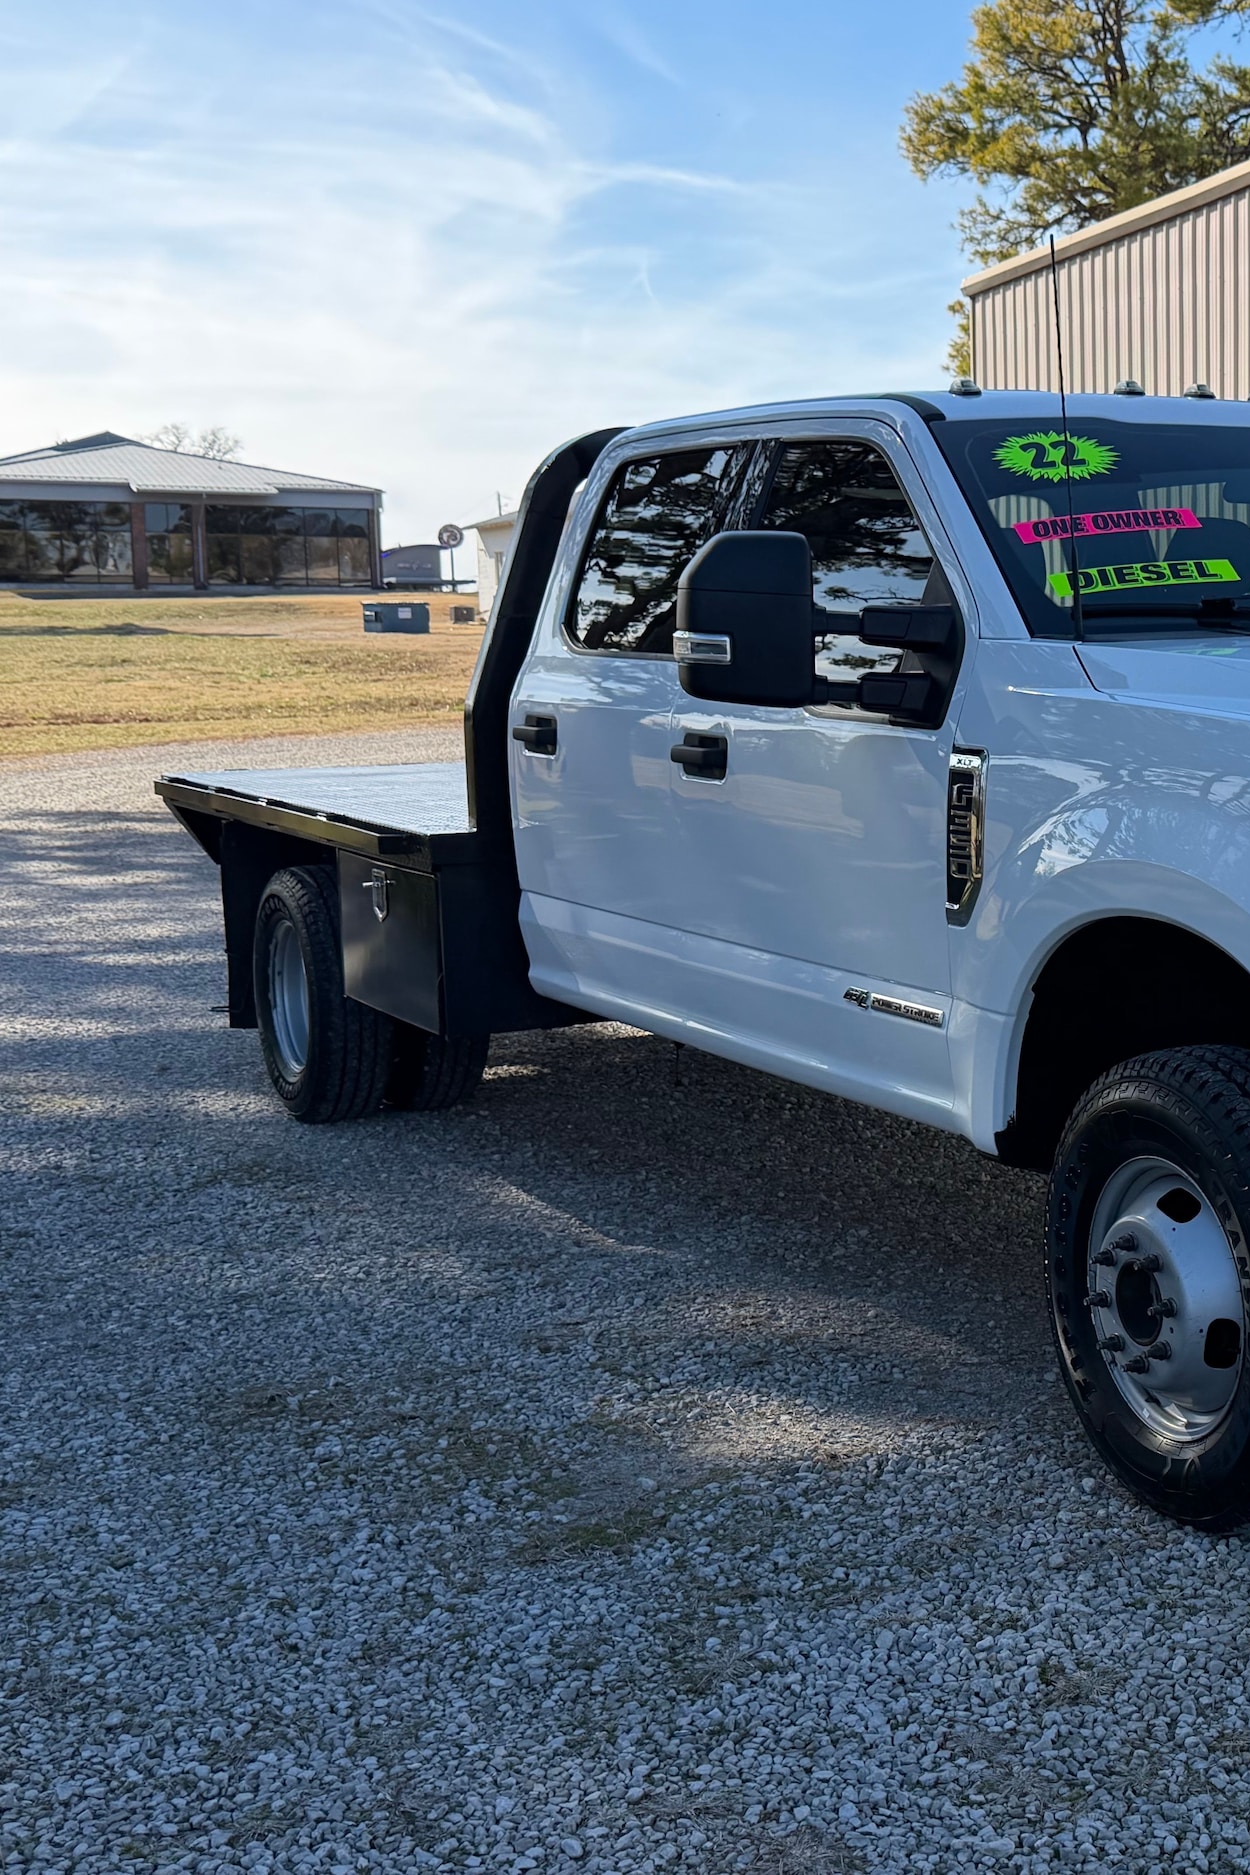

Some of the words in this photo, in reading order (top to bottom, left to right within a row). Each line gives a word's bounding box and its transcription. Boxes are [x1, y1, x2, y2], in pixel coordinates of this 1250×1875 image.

[1019, 440, 1089, 469] 22
[1032, 517, 1088, 538] ONE
[1092, 510, 1183, 531] OWNER
[1067, 561, 1222, 591] DIESEL
[956, 758, 973, 766] XLT
